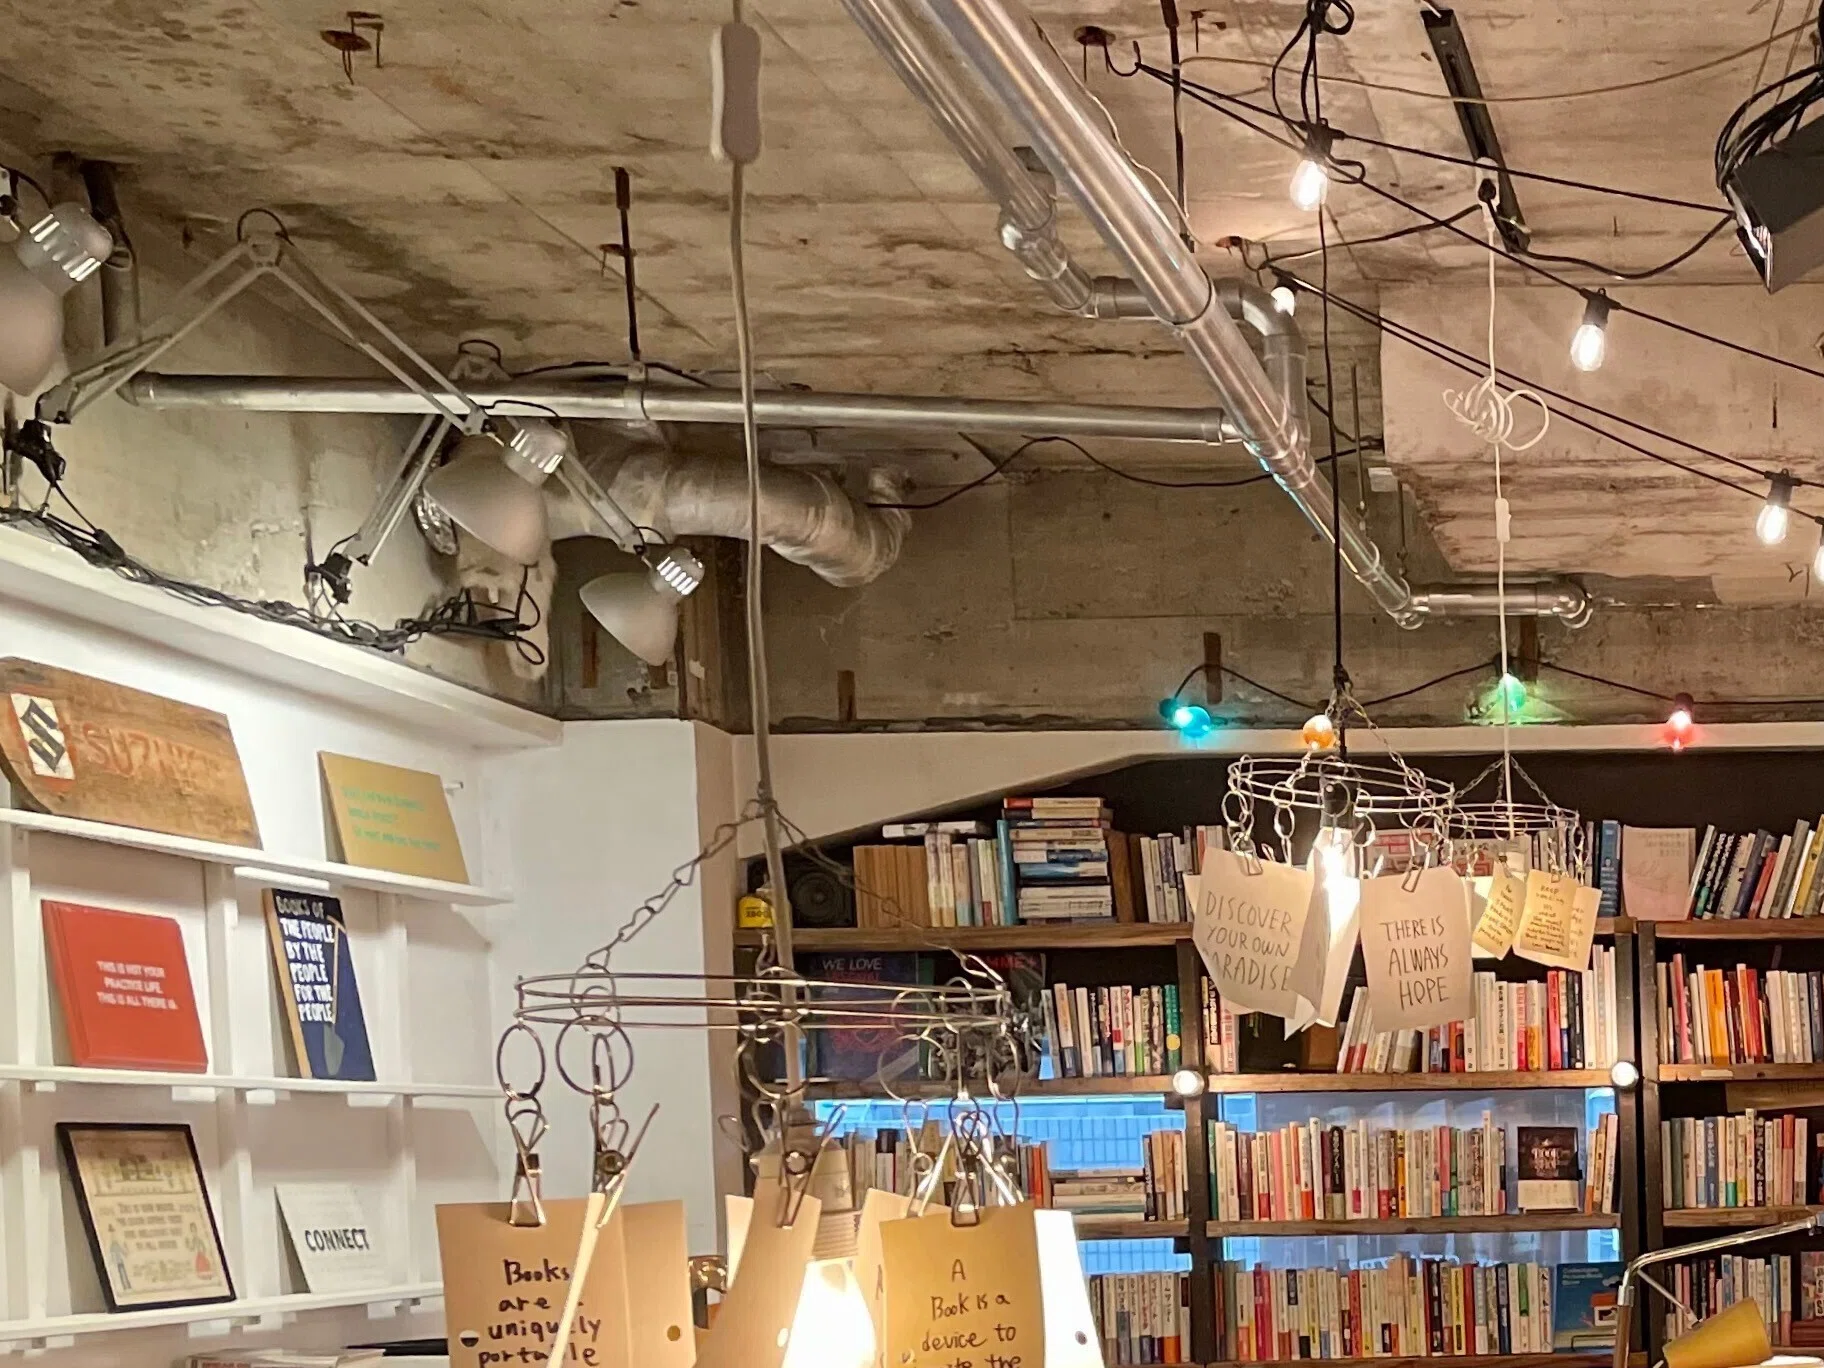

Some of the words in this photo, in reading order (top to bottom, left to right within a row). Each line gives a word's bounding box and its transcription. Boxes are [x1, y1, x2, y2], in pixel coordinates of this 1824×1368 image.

[1205, 890, 1292, 936] DISCOVER
[280, 917, 303, 939] THE
[300, 919, 334, 943] PEOPLE
[1206, 923, 1248, 950] YOUR
[1252, 935, 1290, 957] OWN
[1380, 918, 1428, 942] THERE
[1431, 915, 1445, 937] IS
[285, 940, 301, 960] BY
[301, 941, 325, 963] THE
[822, 958, 845, 970] WE
[849, 957, 883, 971] LOVE
[1388, 943, 1450, 977] ALWAYS
[289, 962, 329, 983] PEOPLE
[293, 983, 314, 1003] FOR
[313, 983, 334, 1002] THE
[1399, 976, 1450, 1011] HOPE
[297, 1002, 333, 1022] PEOPLE
[304, 1227, 370, 1252] CONNECT
[503, 1258, 570, 1286] Books
[951, 1258, 966, 1282] A
[498, 1296, 551, 1312] are
[930, 1292, 970, 1321] Book
[976, 1293, 988, 1310] is
[994, 1294, 1011, 1305] a
[487, 1316, 601, 1343] uniquly
[921, 1329, 988, 1352] device
[993, 1323, 1017, 1342] to
